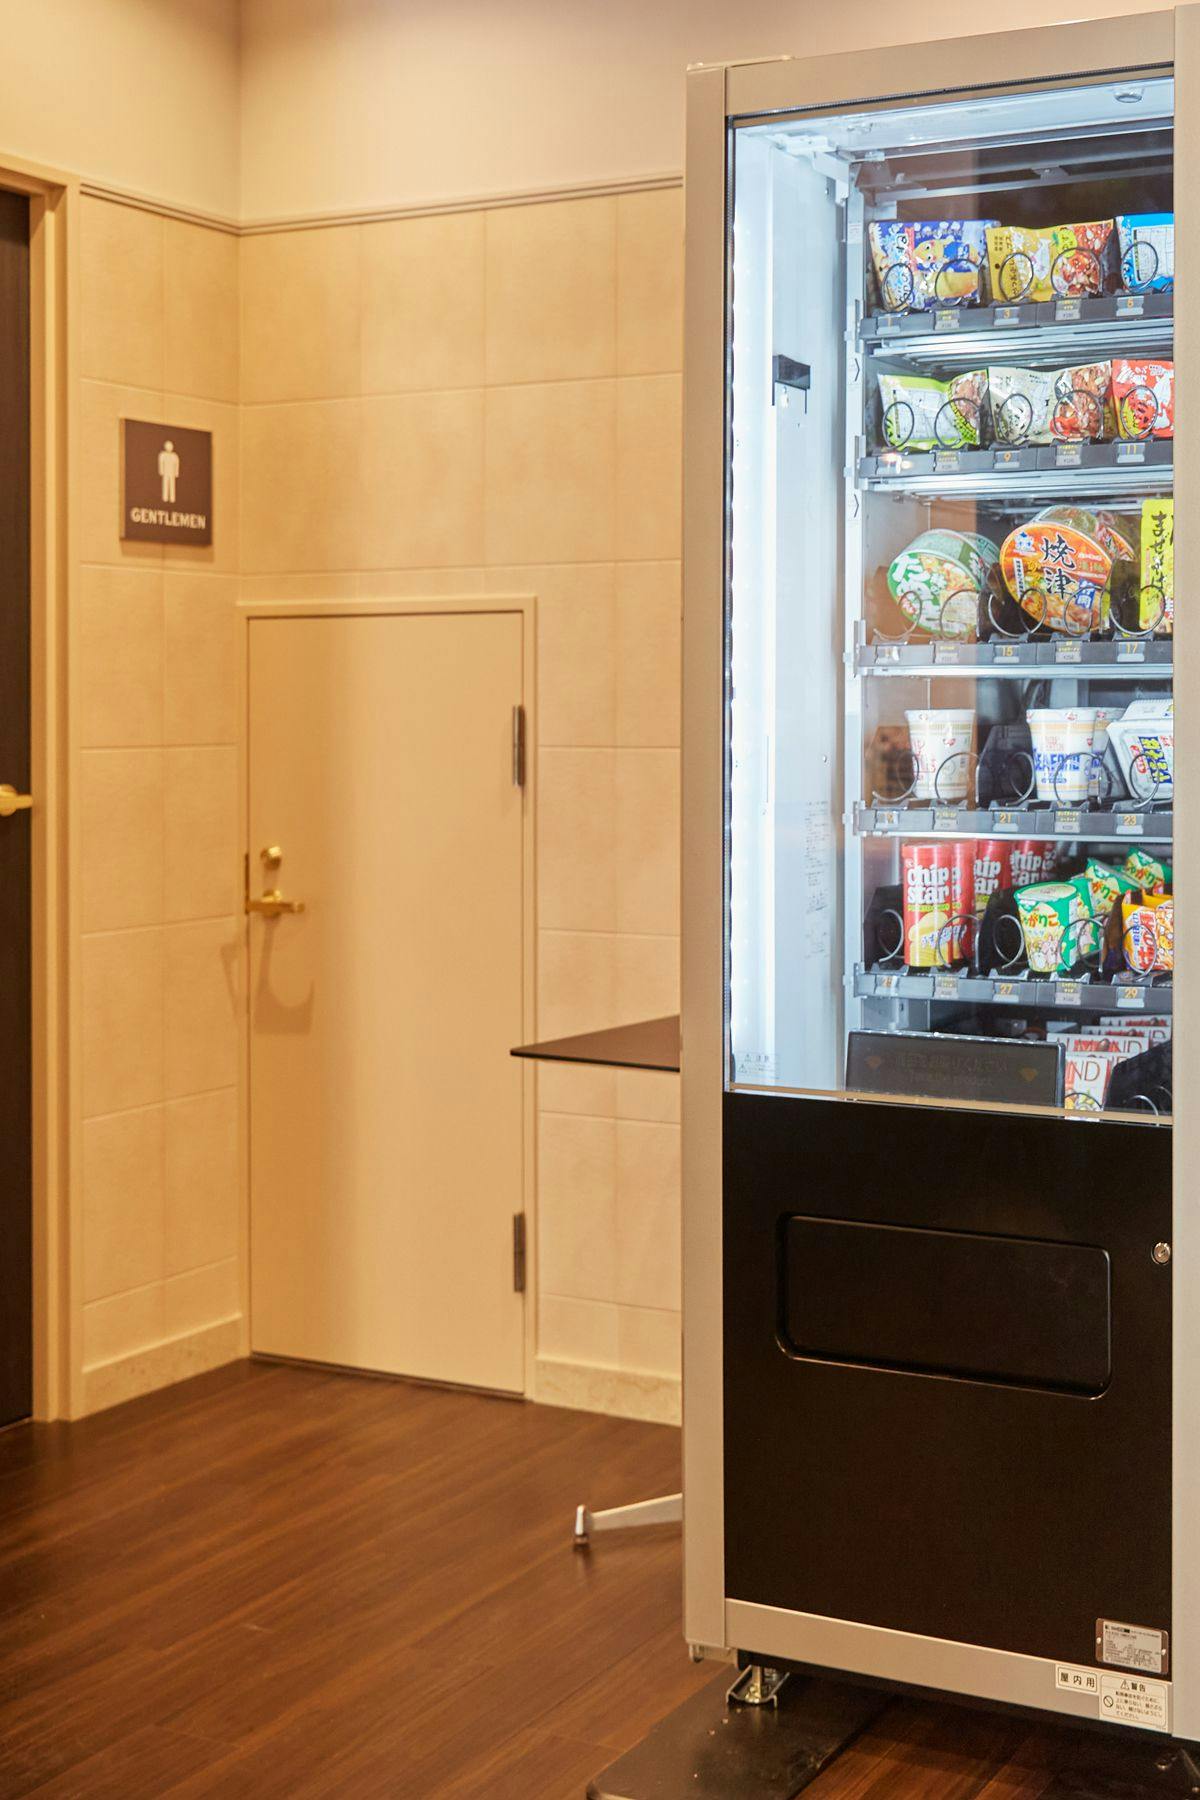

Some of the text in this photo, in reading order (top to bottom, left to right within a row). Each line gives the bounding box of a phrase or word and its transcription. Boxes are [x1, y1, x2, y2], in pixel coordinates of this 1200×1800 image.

[131, 507, 206, 530] GENTLEMEN
[1060, 1672, 1095, 1688] 屋内用
